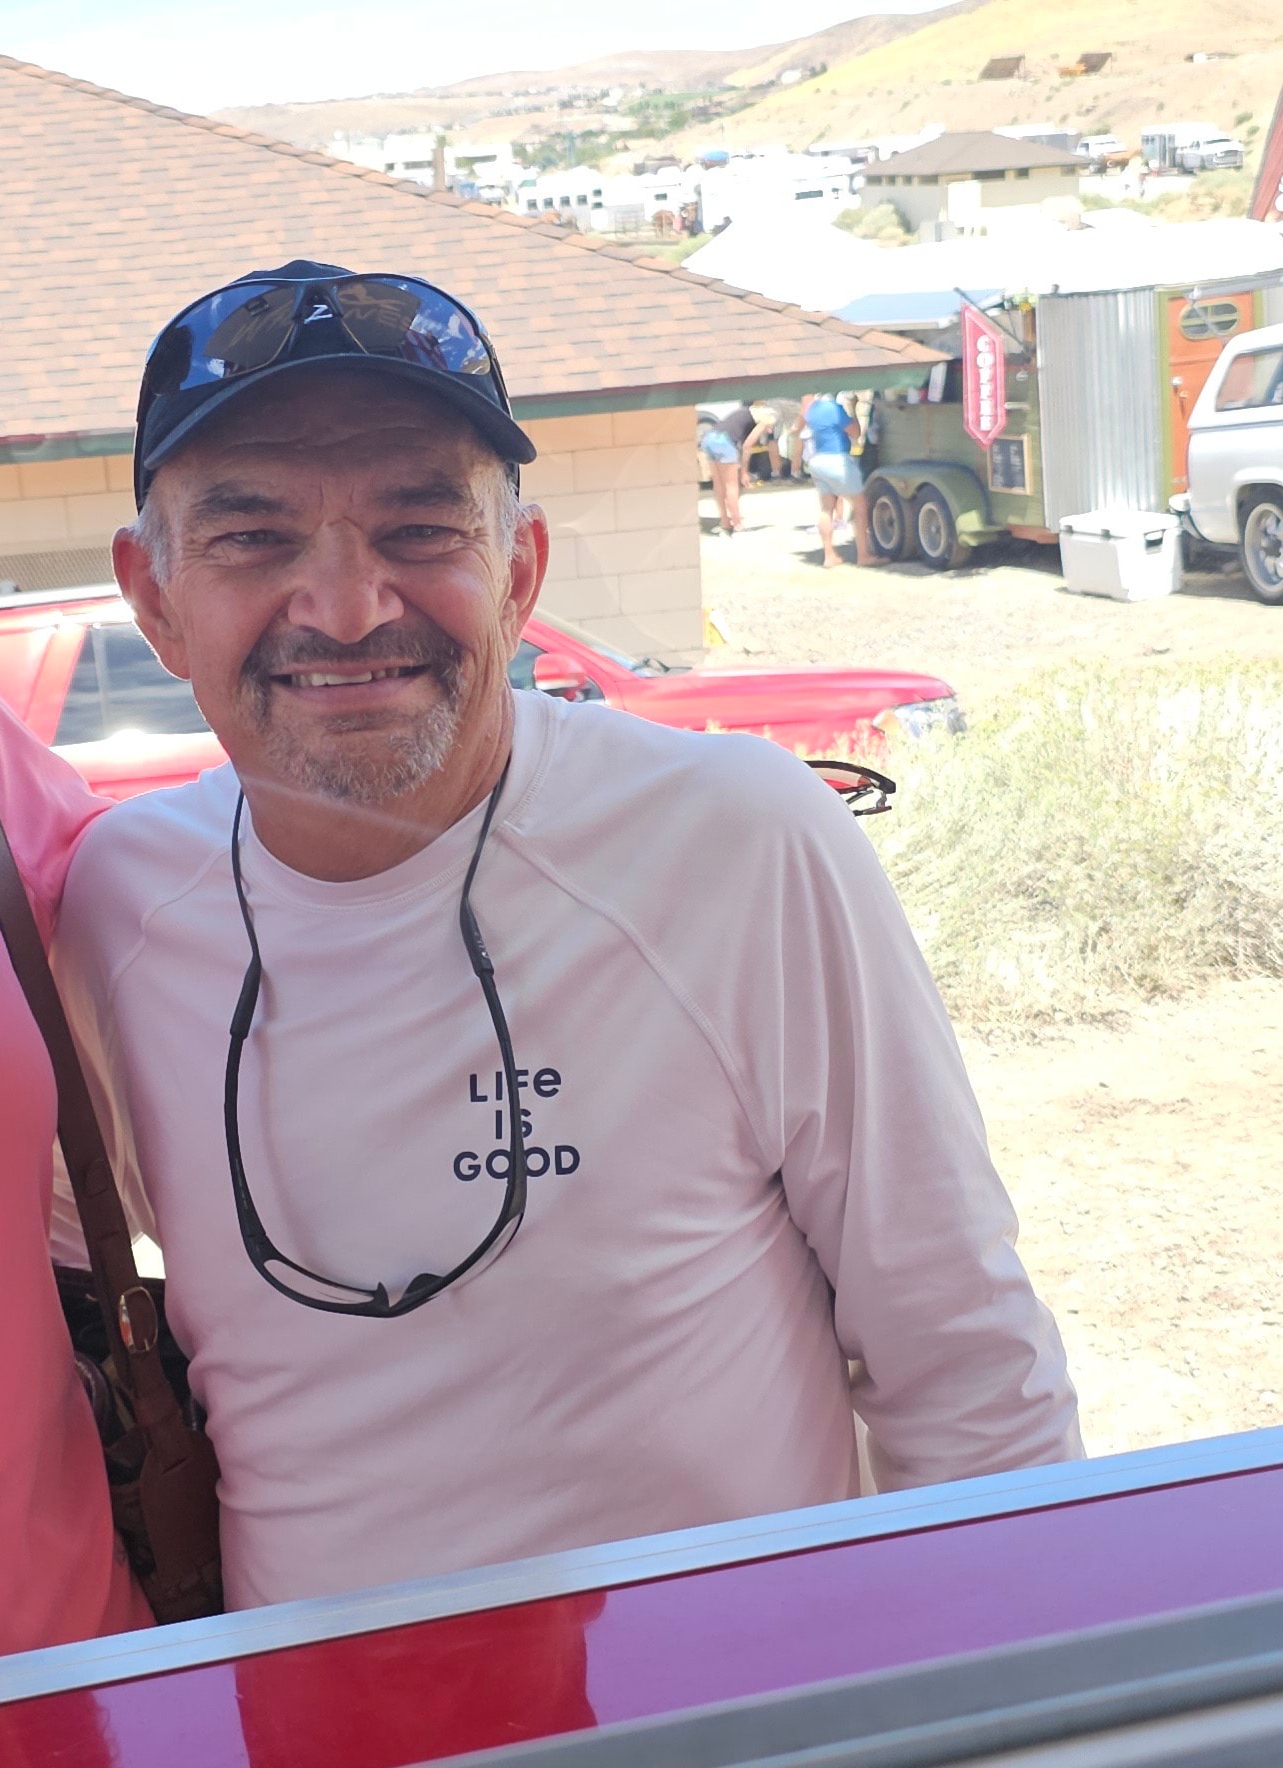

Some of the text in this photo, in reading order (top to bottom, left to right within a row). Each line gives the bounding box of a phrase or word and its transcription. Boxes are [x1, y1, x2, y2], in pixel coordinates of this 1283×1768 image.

[976, 334, 995, 432] COFFEE
[495, 1108, 533, 1140] IS
[453, 1144, 581, 1182] GOOD
